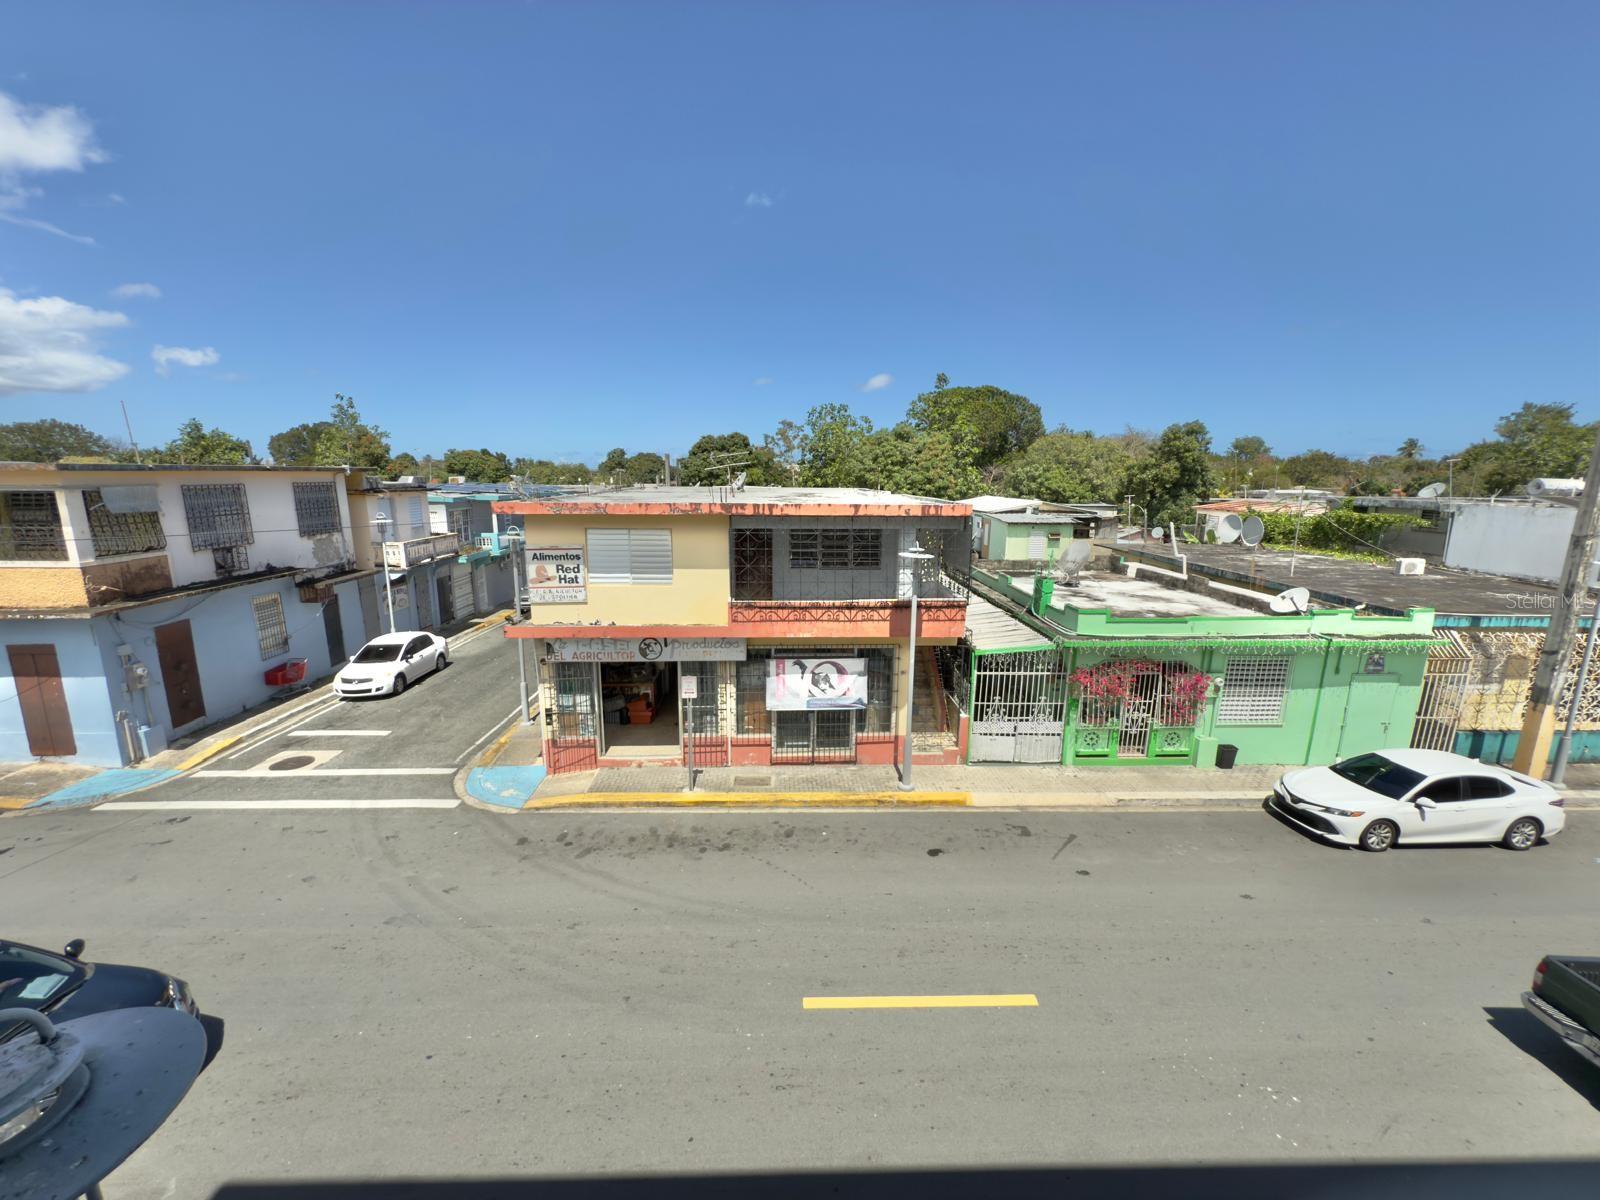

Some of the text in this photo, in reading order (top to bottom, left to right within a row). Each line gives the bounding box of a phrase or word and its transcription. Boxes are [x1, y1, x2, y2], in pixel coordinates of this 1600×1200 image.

[531, 552, 582, 561] Alimentos
[556, 563, 580, 574] Red
[558, 574, 579, 584] Hat
